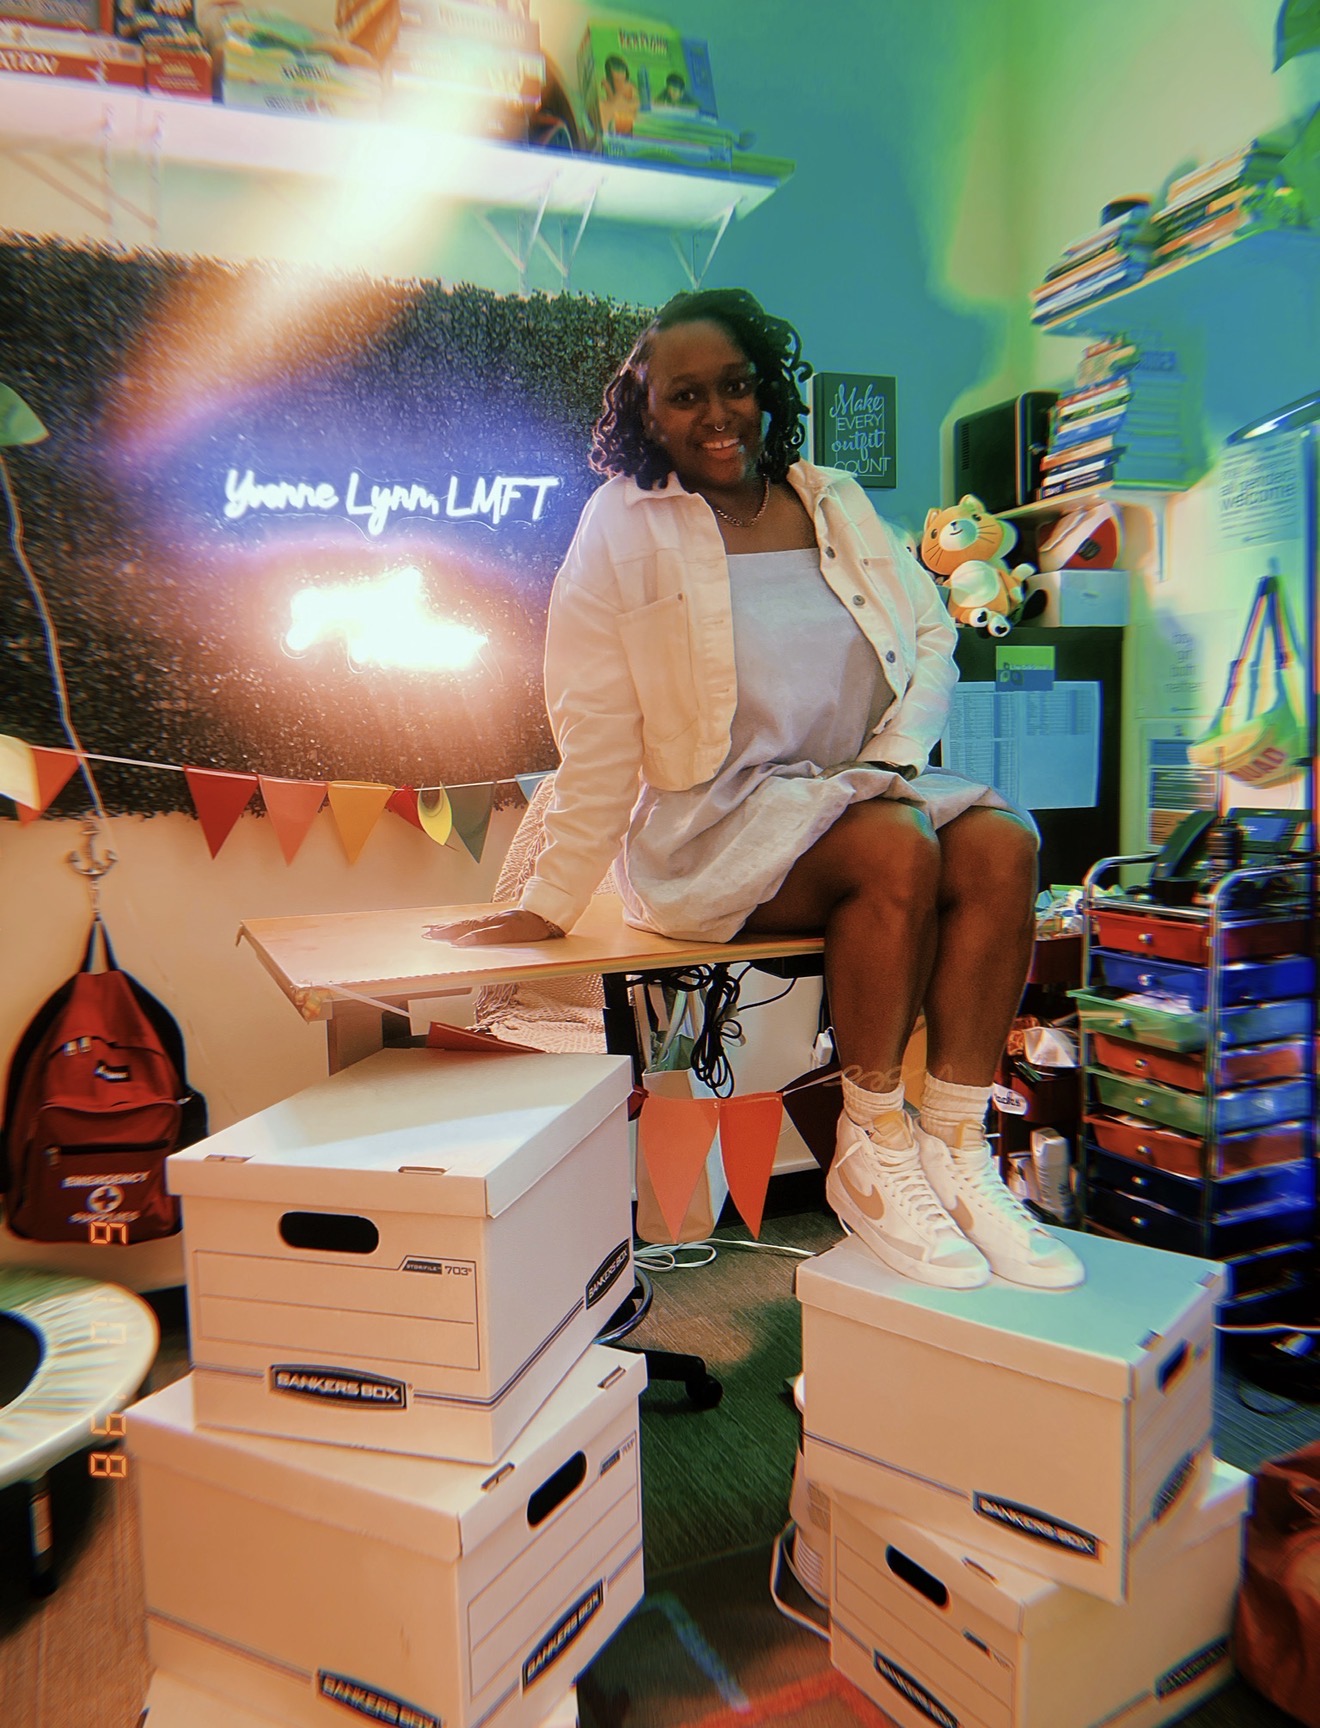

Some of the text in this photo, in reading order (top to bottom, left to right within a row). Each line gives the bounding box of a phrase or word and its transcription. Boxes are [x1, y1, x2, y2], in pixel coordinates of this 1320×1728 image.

[830, 384, 884, 417] Make
[837, 413, 883, 430] EVERY
[831, 429, 886, 461] outfit
[446, 475, 560, 525] LMFT
[276, 1371, 400, 1403] BANKERS BOX
[980, 1497, 1056, 1538] BANKERS
[527, 1612, 578, 1682] BANKERS
[322, 1674, 400, 1724] BANKERS
